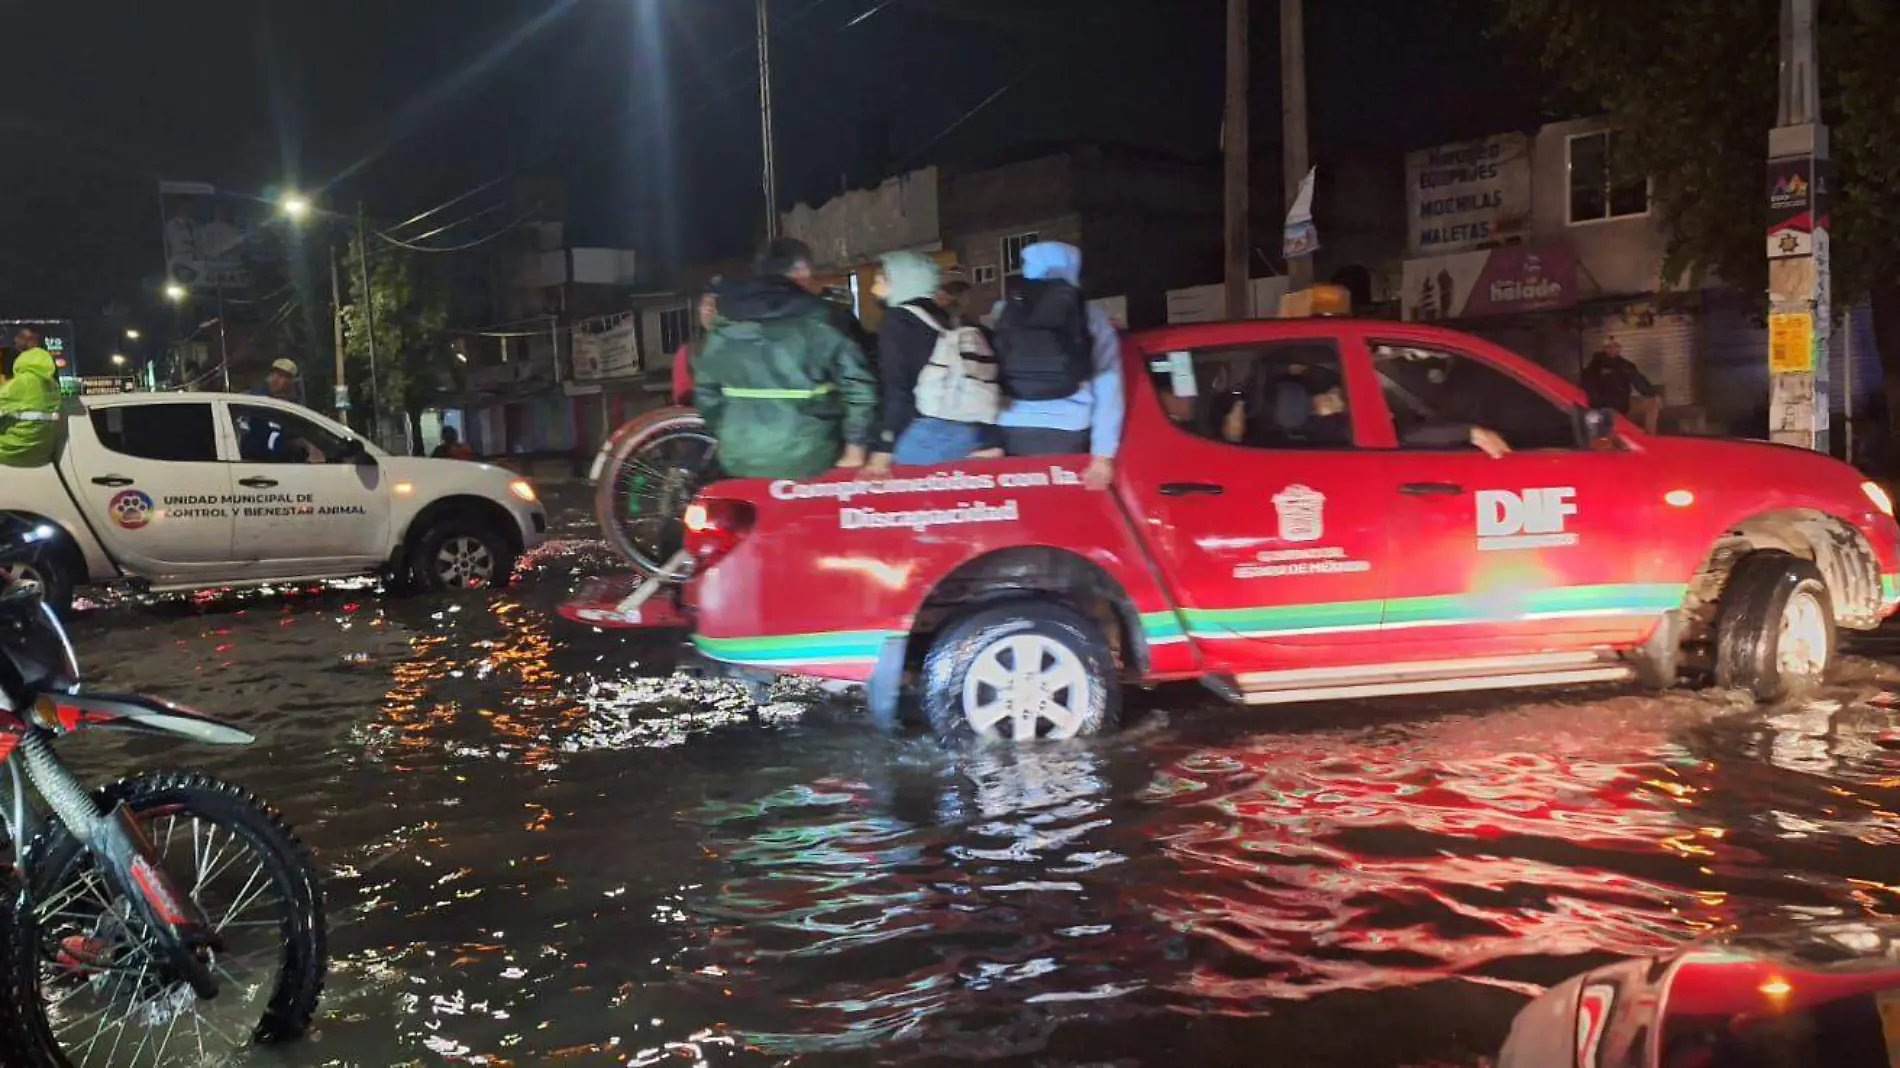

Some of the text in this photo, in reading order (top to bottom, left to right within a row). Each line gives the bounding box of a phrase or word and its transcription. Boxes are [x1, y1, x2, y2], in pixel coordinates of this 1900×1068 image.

[1420, 190, 1502, 217] MOCHILAS
[1420, 221, 1490, 246] MALETAS
[770, 466, 1081, 501] Comprometidos con la
[164, 494, 313, 505] UNIDAD MUNICIPAL DE
[164, 505, 366, 518] CONTROL Y BIENESTAR ANIMAL
[1476, 487, 1577, 536] DIF
[840, 499, 1019, 532] Discapacidad
